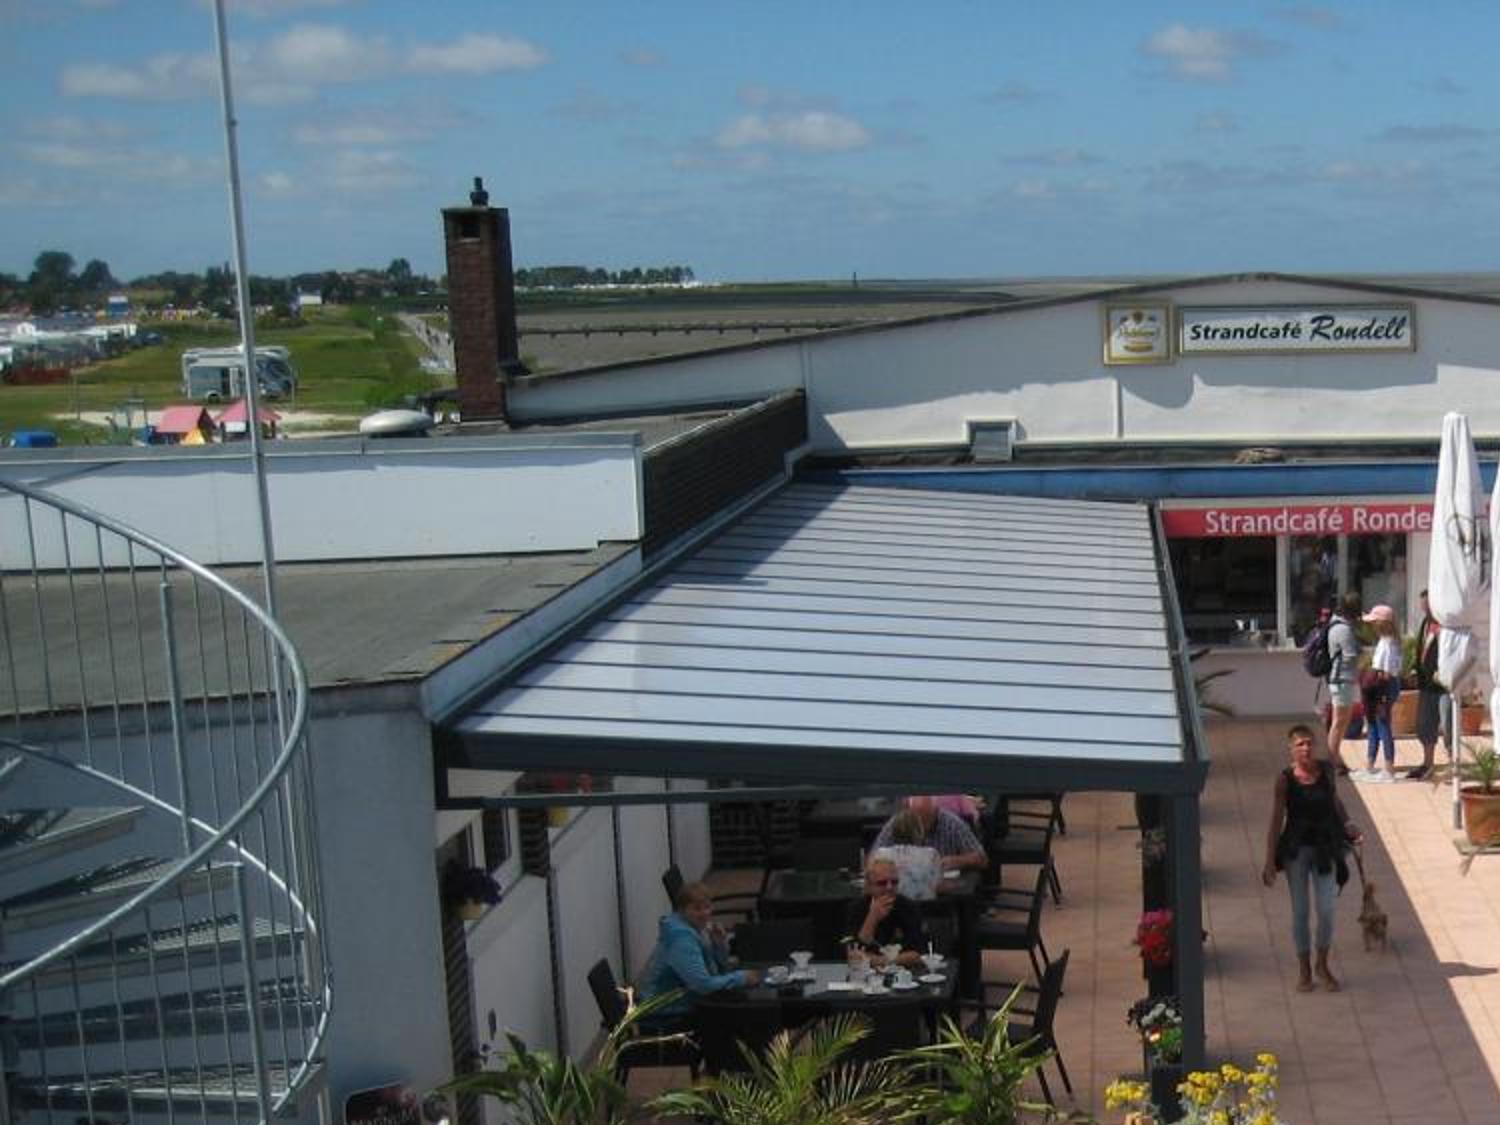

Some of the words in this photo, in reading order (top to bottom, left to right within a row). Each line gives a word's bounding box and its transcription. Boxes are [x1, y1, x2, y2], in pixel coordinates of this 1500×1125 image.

[1190, 321, 1302, 341] Strandcafé
[1309, 314, 1408, 342] Rondell
[1205, 507, 1343, 535] Strandcafé
[1352, 503, 1432, 533] Ronde
